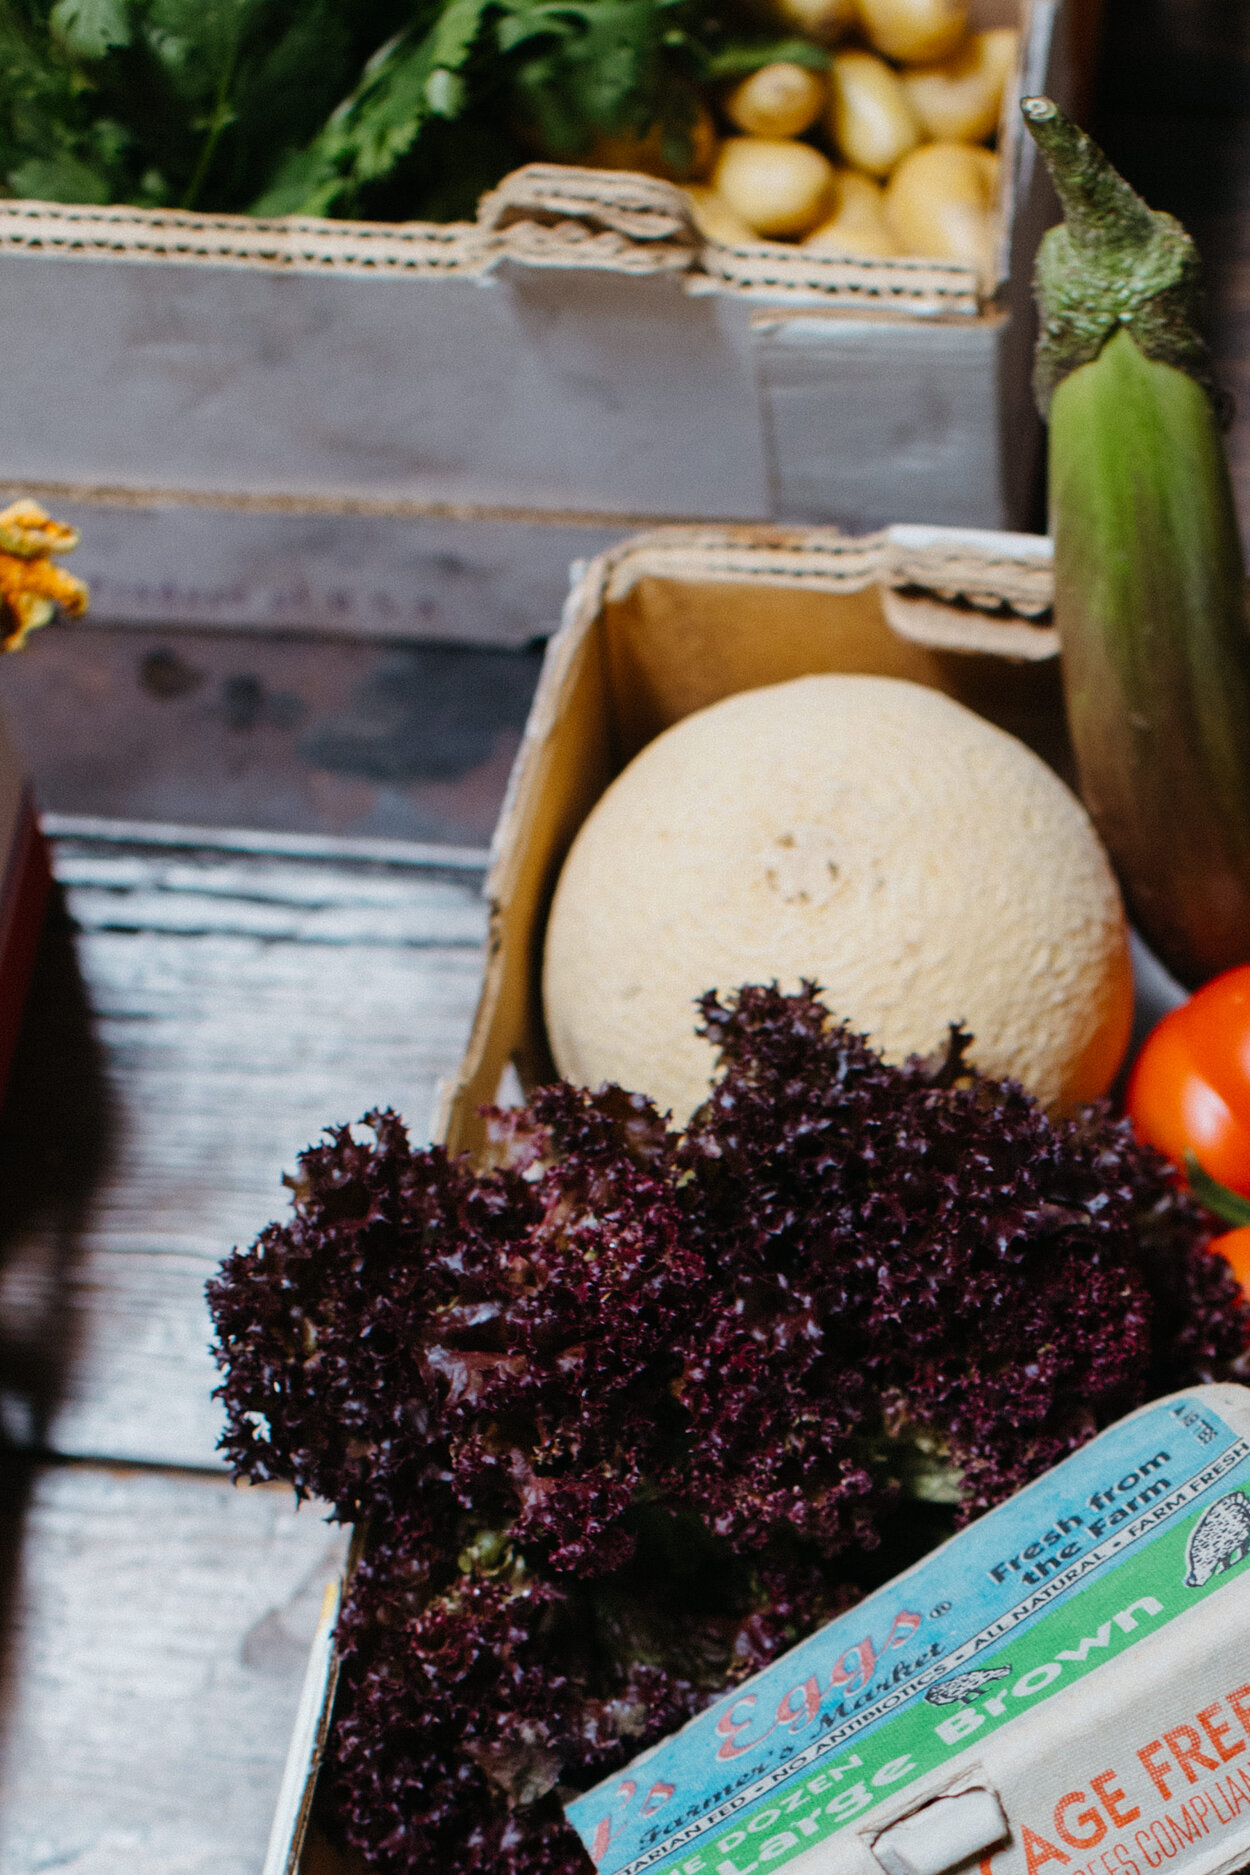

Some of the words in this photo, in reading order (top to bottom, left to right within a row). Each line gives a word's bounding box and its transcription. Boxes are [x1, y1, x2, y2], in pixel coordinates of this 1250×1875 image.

[990, 1514, 1082, 1584] Fresh
[1087, 1451, 1171, 1511] from
[1021, 1540, 1082, 1586] the
[1087, 1477, 1171, 1538] Farm
[706, 1795, 748, 1824] FED
[771, 1756, 808, 1783] NO
[814, 1662, 948, 1756] ANTIBIOTICS
[973, 1622, 1010, 1652] ALL
[1013, 1551, 1106, 1622] NATURAL
[1127, 1494, 1188, 1538] FARM
[1189, 1442, 1250, 1493] FRESH
[933, 1594, 1166, 1748] Brown
[639, 1745, 794, 1851] Farmer's
[810, 1642, 946, 1740] Market
[715, 1752, 864, 1855] DOZEN
